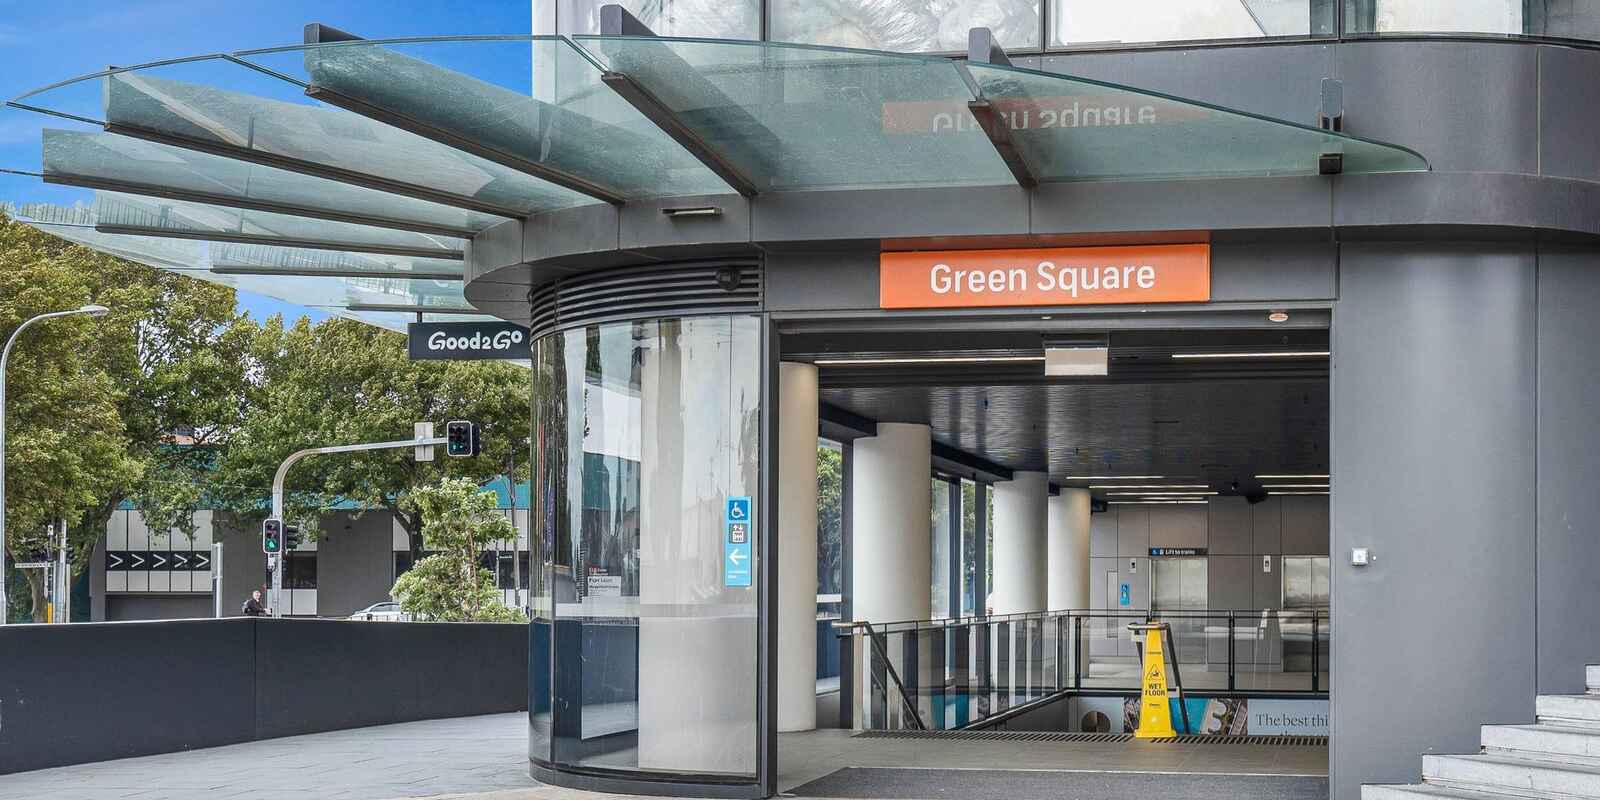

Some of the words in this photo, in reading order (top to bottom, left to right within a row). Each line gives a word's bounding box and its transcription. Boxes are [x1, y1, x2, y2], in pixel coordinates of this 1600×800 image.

[930, 263, 1028, 294] Green
[1036, 261, 1156, 298] Square
[427, 330, 523, 351] Good2Go
[1145, 689, 1166, 697] FLOOR
[1256, 713, 1280, 727] The
[1282, 713, 1309, 727] best
